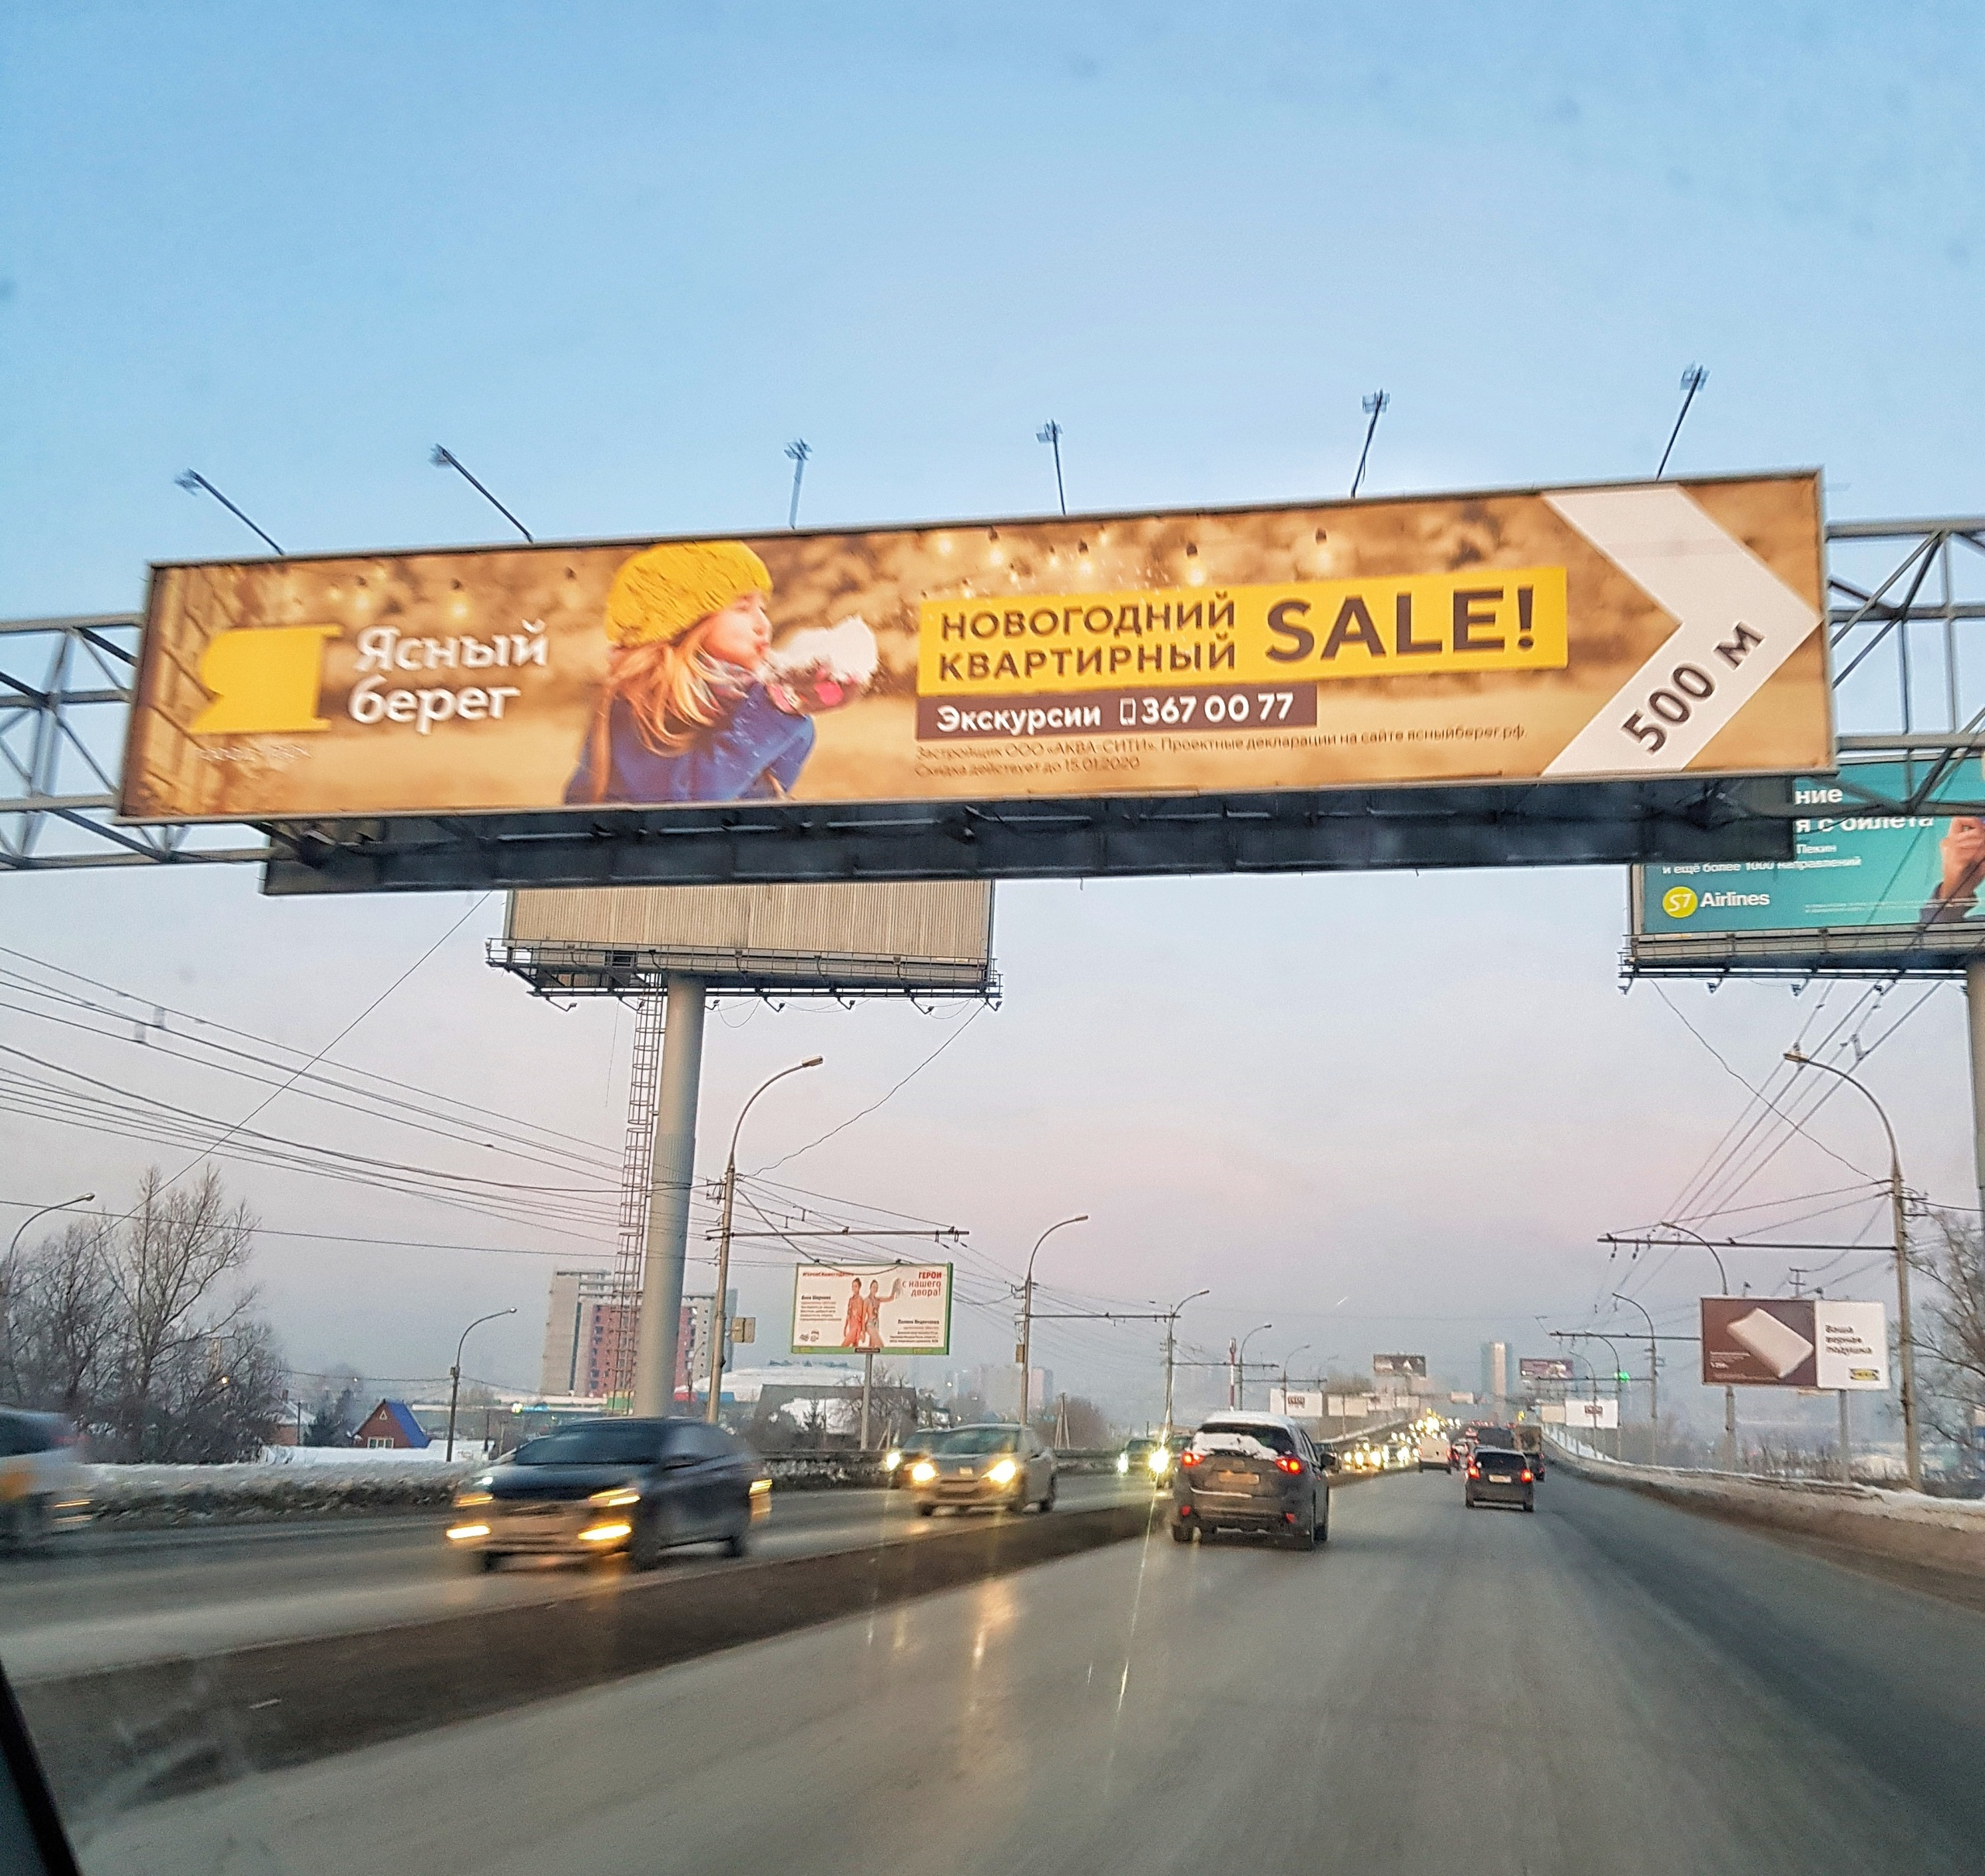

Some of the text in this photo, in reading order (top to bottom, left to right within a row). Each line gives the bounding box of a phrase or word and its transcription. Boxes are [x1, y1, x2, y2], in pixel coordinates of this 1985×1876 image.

[941, 591, 1235, 642] НОВОГОДНИЙ
[1265, 584, 1534, 664] SALE!
[353, 619, 549, 672] Ясный
[939, 632, 1235, 682] КВАРТИРНЫЙ
[348, 674, 521, 735] берег
[936, 691, 1294, 736] Экскурсии 367 00 77
[1621, 665, 1716, 755] 500
[1162, 736, 1244, 754] Проектные
[1246, 734, 1336, 752] декларации
[1340, 732, 1358, 746] на
[1361, 727, 1404, 745] сайте
[1703, 862, 1742, 874] более
[1700, 891, 1771, 909] Airlines
